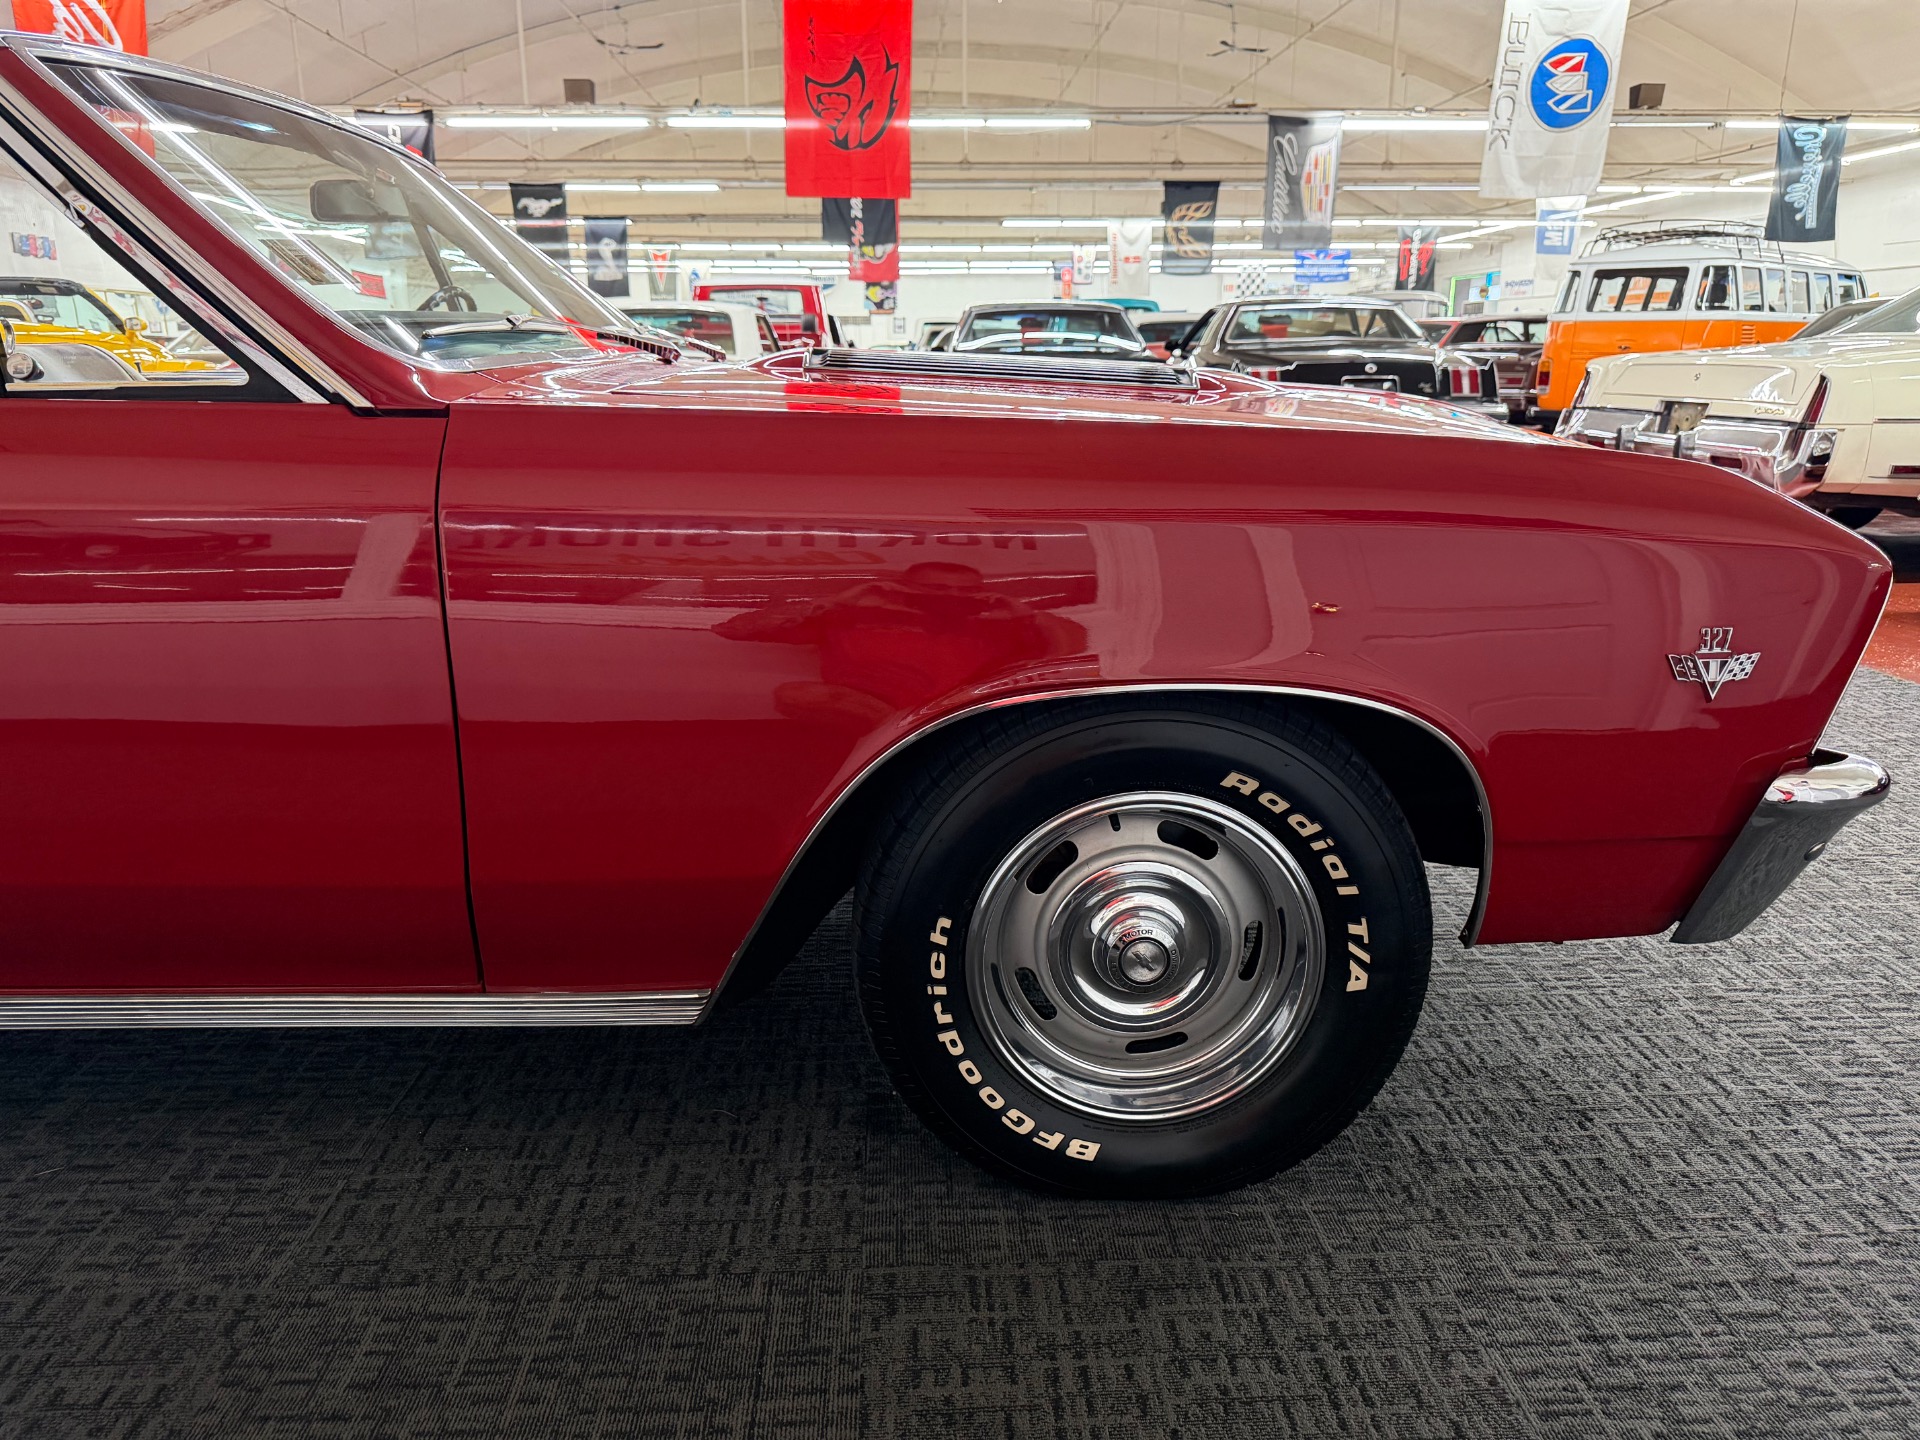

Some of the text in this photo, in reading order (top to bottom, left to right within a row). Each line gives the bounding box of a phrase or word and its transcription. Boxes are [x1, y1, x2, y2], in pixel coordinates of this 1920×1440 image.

[1488, 12, 1531, 151] BUICK
[1270, 132, 1299, 235] Cadillac
[1699, 626, 1734, 652] 327
[1124, 929, 1153, 940] MOTOR
[1219, 771, 1371, 993] Radial T/A
[926, 916, 1102, 1162] BFGoodrich
